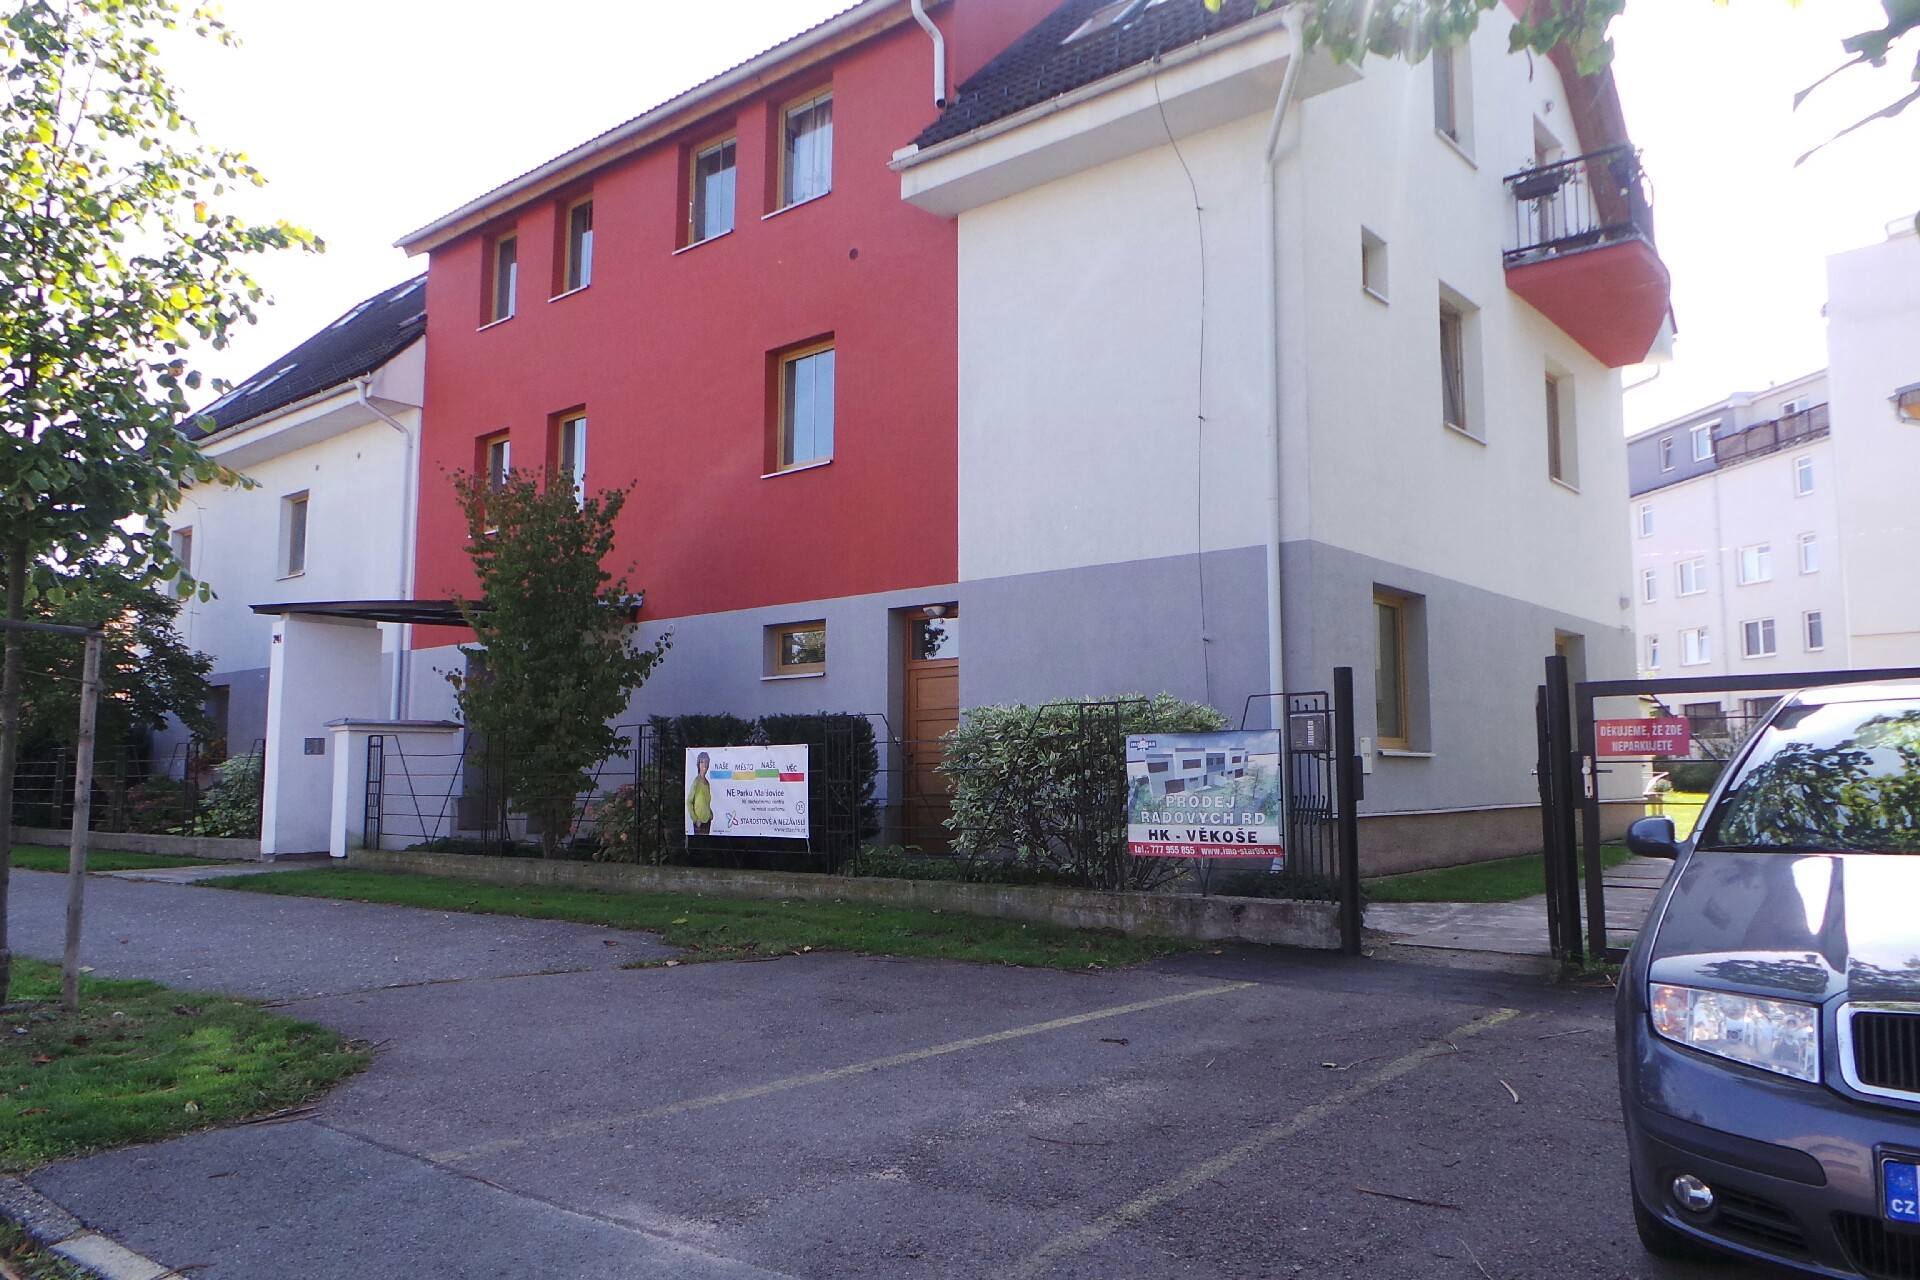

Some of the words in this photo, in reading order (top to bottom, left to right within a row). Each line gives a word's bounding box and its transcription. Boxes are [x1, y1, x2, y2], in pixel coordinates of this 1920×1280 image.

[1600, 723, 1650, 738] DĚKUJEME,
[1651, 723, 1664, 736] ŽE
[1665, 724, 1683, 736] ZDE
[1612, 740, 1674, 752] NEPARKUJETE
[714, 762, 729, 770] NAŠE
[734, 763, 754, 771] MĚSTO
[760, 760, 776, 769] NAŠE
[786, 763, 798, 772] VĚC
[726, 789, 736, 797] NE
[736, 789, 753, 797] Parku
[1165, 795, 1236, 808] PRODEJ
[740, 817, 772, 826] STAROSTOVÉ
[773, 818, 778, 826] A
[778, 817, 806, 826] NEZÁVISLÍ
[1140, 808, 1235, 825] ŘADOVÝCH
[1241, 812, 1266, 825] RD
[1148, 829, 1171, 841] HK
[1186, 827, 1258, 844] VĚKOŠE
[1134, 845, 1149, 854] tel.:
[1150, 845, 1164, 854] 777
[1165, 845, 1179, 855] 955
[1891, 1198, 1916, 1215] CZ
